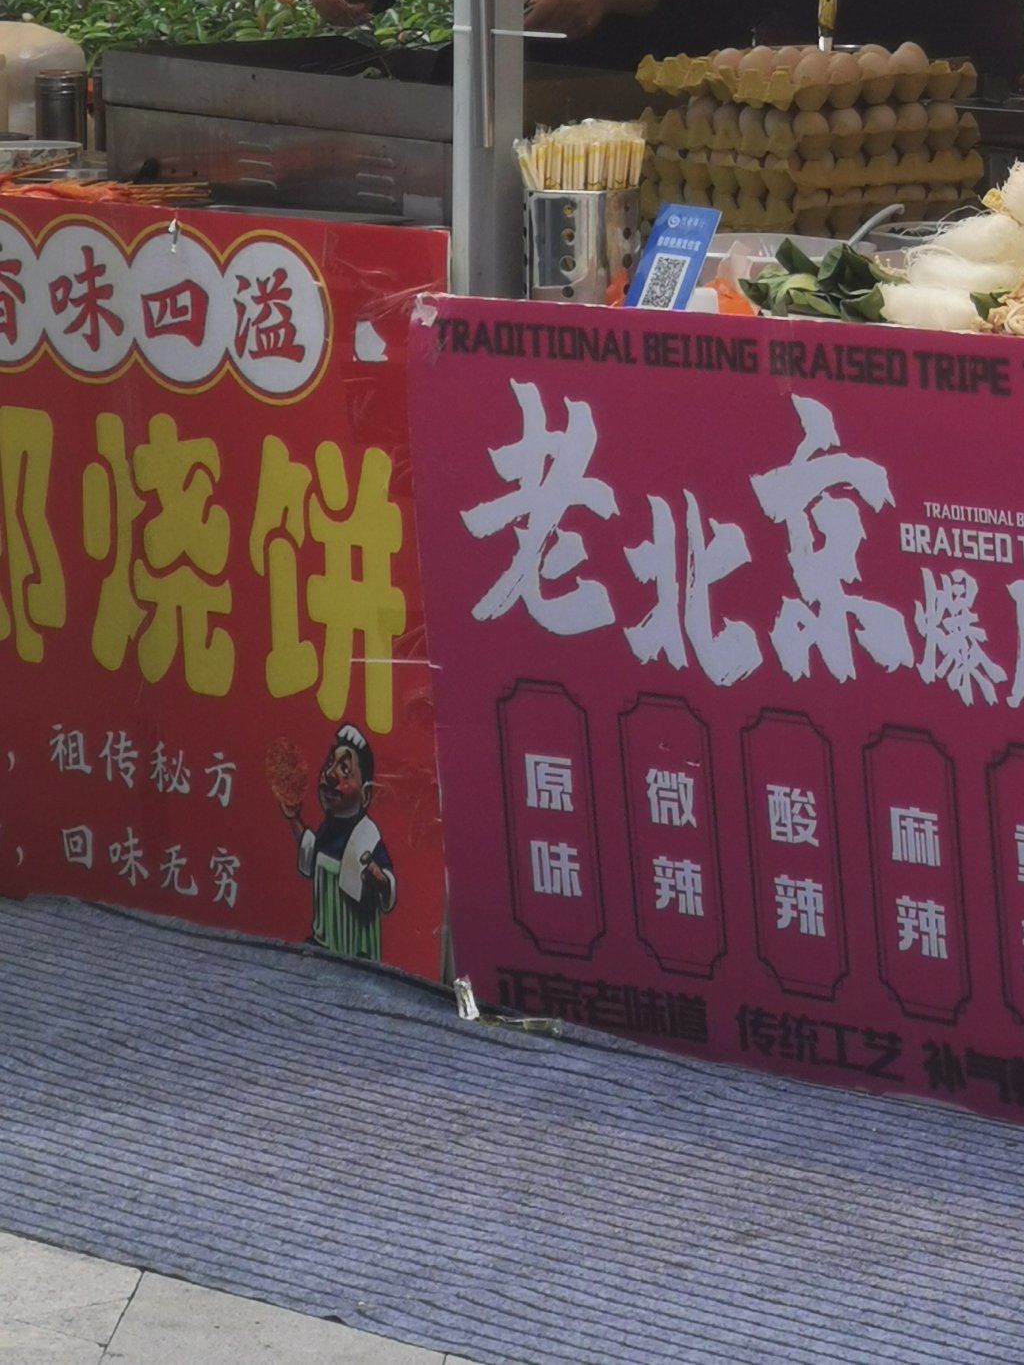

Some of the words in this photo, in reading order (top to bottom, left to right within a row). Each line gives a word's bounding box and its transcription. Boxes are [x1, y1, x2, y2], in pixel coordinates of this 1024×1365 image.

[436, 319, 636, 366] TRADITIONAL
[643, 329, 758, 374] BEIJING
[769, 337, 906, 388] BRAISED
[914, 351, 1010, 397] TRIPE
[900, 522, 1013, 564] BRAISED
[924, 501, 1014, 526] TRADITIONAL
[524, 753, 582, 898] 原味
[645, 767, 704, 917] 微辣
[765, 784, 827, 938] 酸辣
[890, 806, 948, 960] 麻辣
[736, 1004, 905, 1082] 传统工艺
